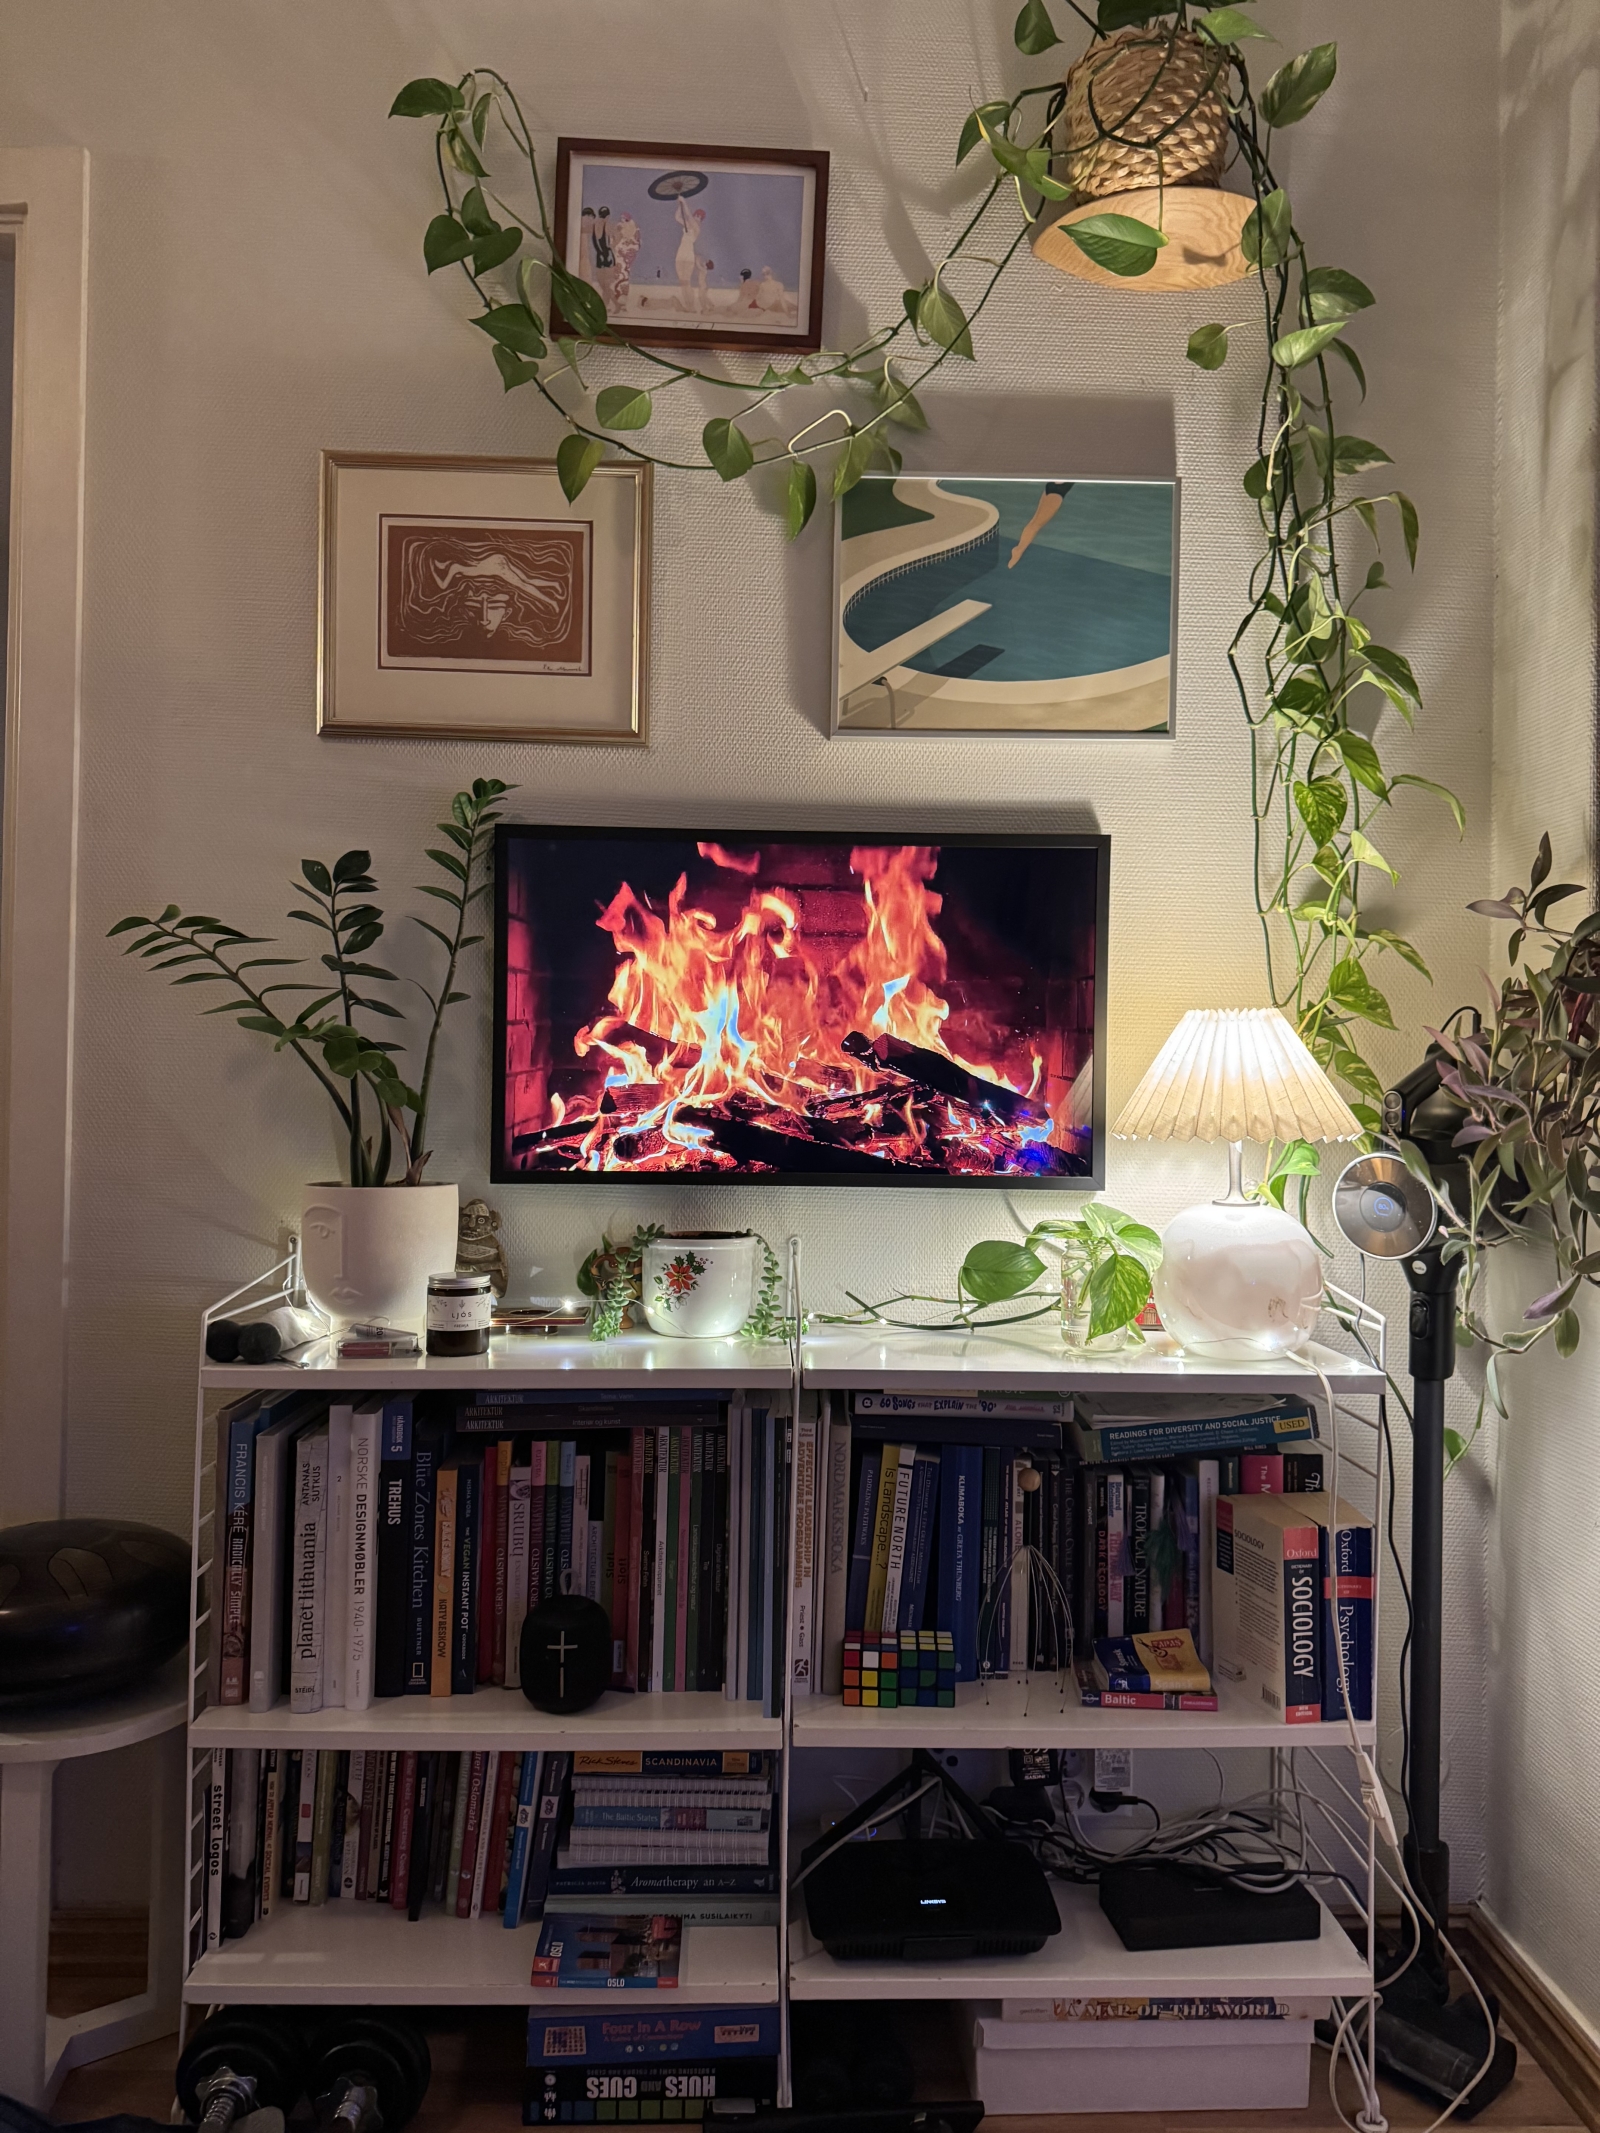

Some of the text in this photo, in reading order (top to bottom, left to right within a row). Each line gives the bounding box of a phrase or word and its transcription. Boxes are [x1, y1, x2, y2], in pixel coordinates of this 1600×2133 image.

[451, 1311, 482, 1320] LJÓS
[464, 1407, 504, 1417] ARKITEKTUR
[485, 1394, 525, 1404] ARKITEKTUR
[879, 1398, 890, 1408] 60
[891, 1396, 915, 1410] SONGS
[396, 1415, 406, 1444] HÅNDBOK
[465, 1417, 621, 1430] ARKITEKTUR Interiør og kunst
[1109, 1415, 1280, 1440] READINGS FOR DIVERSITY AND SOCIAL JUSTICE
[1279, 1419, 1305, 1431] USED
[356, 1437, 369, 1490] NORSKE
[391, 1445, 403, 1453] 5
[633, 1434, 642, 1474] ARKITEKTUR
[644, 1434, 654, 1474] ARKITEKTUR
[670, 1435, 679, 1475] ARKITEKTUR
[680, 1435, 690, 1475] ARKITEKTUR
[692, 1434, 702, 1473] ARKITEKTUR
[704, 1432, 714, 1471] ARKITEKTUR
[716, 1434, 726, 1473] ARKITEKTUR
[301, 1462, 312, 1507] ANTANAS
[311, 1466, 321, 1503] SUTKUS
[885, 1467, 897, 1478] Is
[1064, 1475, 1075, 1495] THE
[1260, 1465, 1268, 1480] The
[387, 1478, 403, 1526] TREHUS
[656, 1434, 667, 1596] ARKITEKTUR Arkitekturopprøret
[794, 1441, 806, 1589] ADVENTURE PROGRAMMING
[802, 1441, 814, 1578] EFFECTIVE LEADERSHIP IN
[831, 1441, 848, 1575] NORDMARKSBOKA
[860, 1469, 874, 1546] PADDLING PATHWAYS
[894, 1472, 910, 1523] FUTURE
[1114, 1481, 1122, 1511] Bernard
[228, 1443, 248, 1624] FRANCIS KÉRÉ RADICALLY SIMPLE
[411, 1451, 432, 1608] Blue Zones Kitchen
[509, 1502, 526, 1557] SRIUBŲ
[876, 1481, 896, 1570] Landscape...?
[1064, 1497, 1075, 1535] CARBON
[353, 1494, 367, 1595] DESIGNMØBLER
[439, 1521, 452, 1578] FAKEAWAY
[463, 1537, 471, 1570] VEGAN
[890, 1525, 904, 1570] NORTH
[955, 1475, 966, 1602] KLIMABOKA GRETA THUNBERG
[1064, 1537, 1074, 1567] CYCLE
[1234, 1528, 1265, 1550] SOCIOLOGY
[1286, 1547, 1318, 1558] Oxford
[1340, 1530, 1354, 1573] Oxford
[496, 1547, 505, 1586] MAISTO
[531, 1548, 540, 1586] MAISTO
[606, 1551, 615, 1578] Sloft
[616, 1558, 627, 1584] Sloft
[1098, 1530, 1107, 1611] DARK ECOLOGY
[1109, 1530, 1122, 1603] THE WAY
[1134, 1502, 1147, 1618] TROPICAL NATURE
[297, 1522, 317, 1660] planet lithuania
[461, 1571, 470, 1609] INSTANT
[496, 1588, 504, 1615] GERO
[352, 1599, 366, 1662] 1940-1975
[415, 1616, 423, 1656] BUETTNER
[437, 1598, 448, 1658] KATY BESKOW
[797, 1605, 807, 1648] Priest Gass
[1291, 1576, 1314, 1678] SOCIOLOGY
[295, 1687, 315, 1695] STEIDL
[1104, 1694, 1136, 1705] Baltic
[578, 1755, 639, 1767] Rick Steves
[645, 1756, 718, 1767] SCANDINAVIA
[266, 1798, 274, 1819] APPEAR
[363, 1783, 373, 1810] STYLE
[467, 1777, 481, 1831] Oslomarka
[209, 1784, 223, 1876] street logos
[398, 1758, 414, 1877] She Feels Courtney Cook
[454, 1796, 466, 1849] Oslomarka
[602, 1812, 658, 1822] The Baltic States
[264, 1850, 272, 1874] SOCIAL
[630, 1875, 715, 1890] Aromatherapy an
[549, 1941, 564, 1958] OSLO
[607, 1978, 625, 1988] OSLO
[602, 2019, 702, 2035] Four In A Row
[1019, 2003, 1290, 2017] gestalten MAP OF THE WORLD
[585, 2075, 716, 2099] HUES AND CUES
